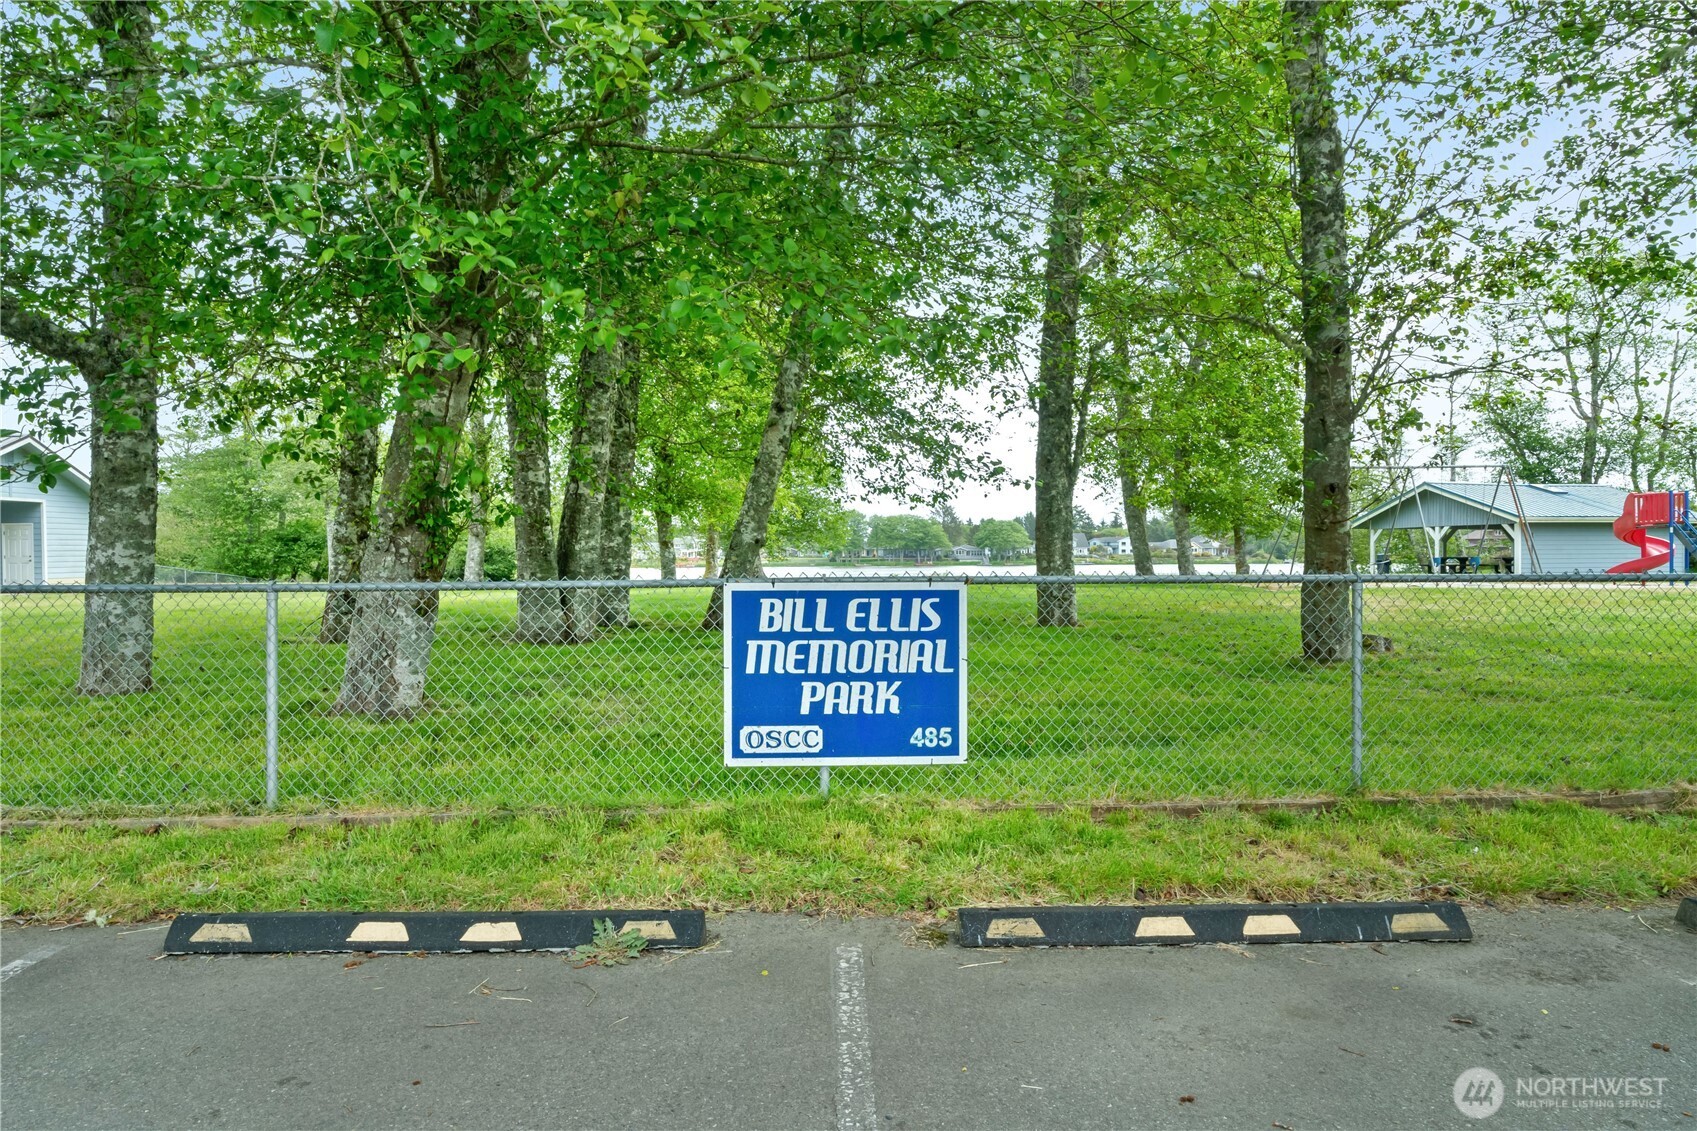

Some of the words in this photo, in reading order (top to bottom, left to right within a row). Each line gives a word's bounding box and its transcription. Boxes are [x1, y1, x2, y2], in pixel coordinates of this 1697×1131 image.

[758, 598, 835, 632] BILL
[846, 597, 942, 632] ELLIS
[745, 639, 954, 674] MEMORIAL
[800, 681, 902, 715] PARK
[745, 730, 820, 749] OSCC
[909, 727, 953, 748] 485
